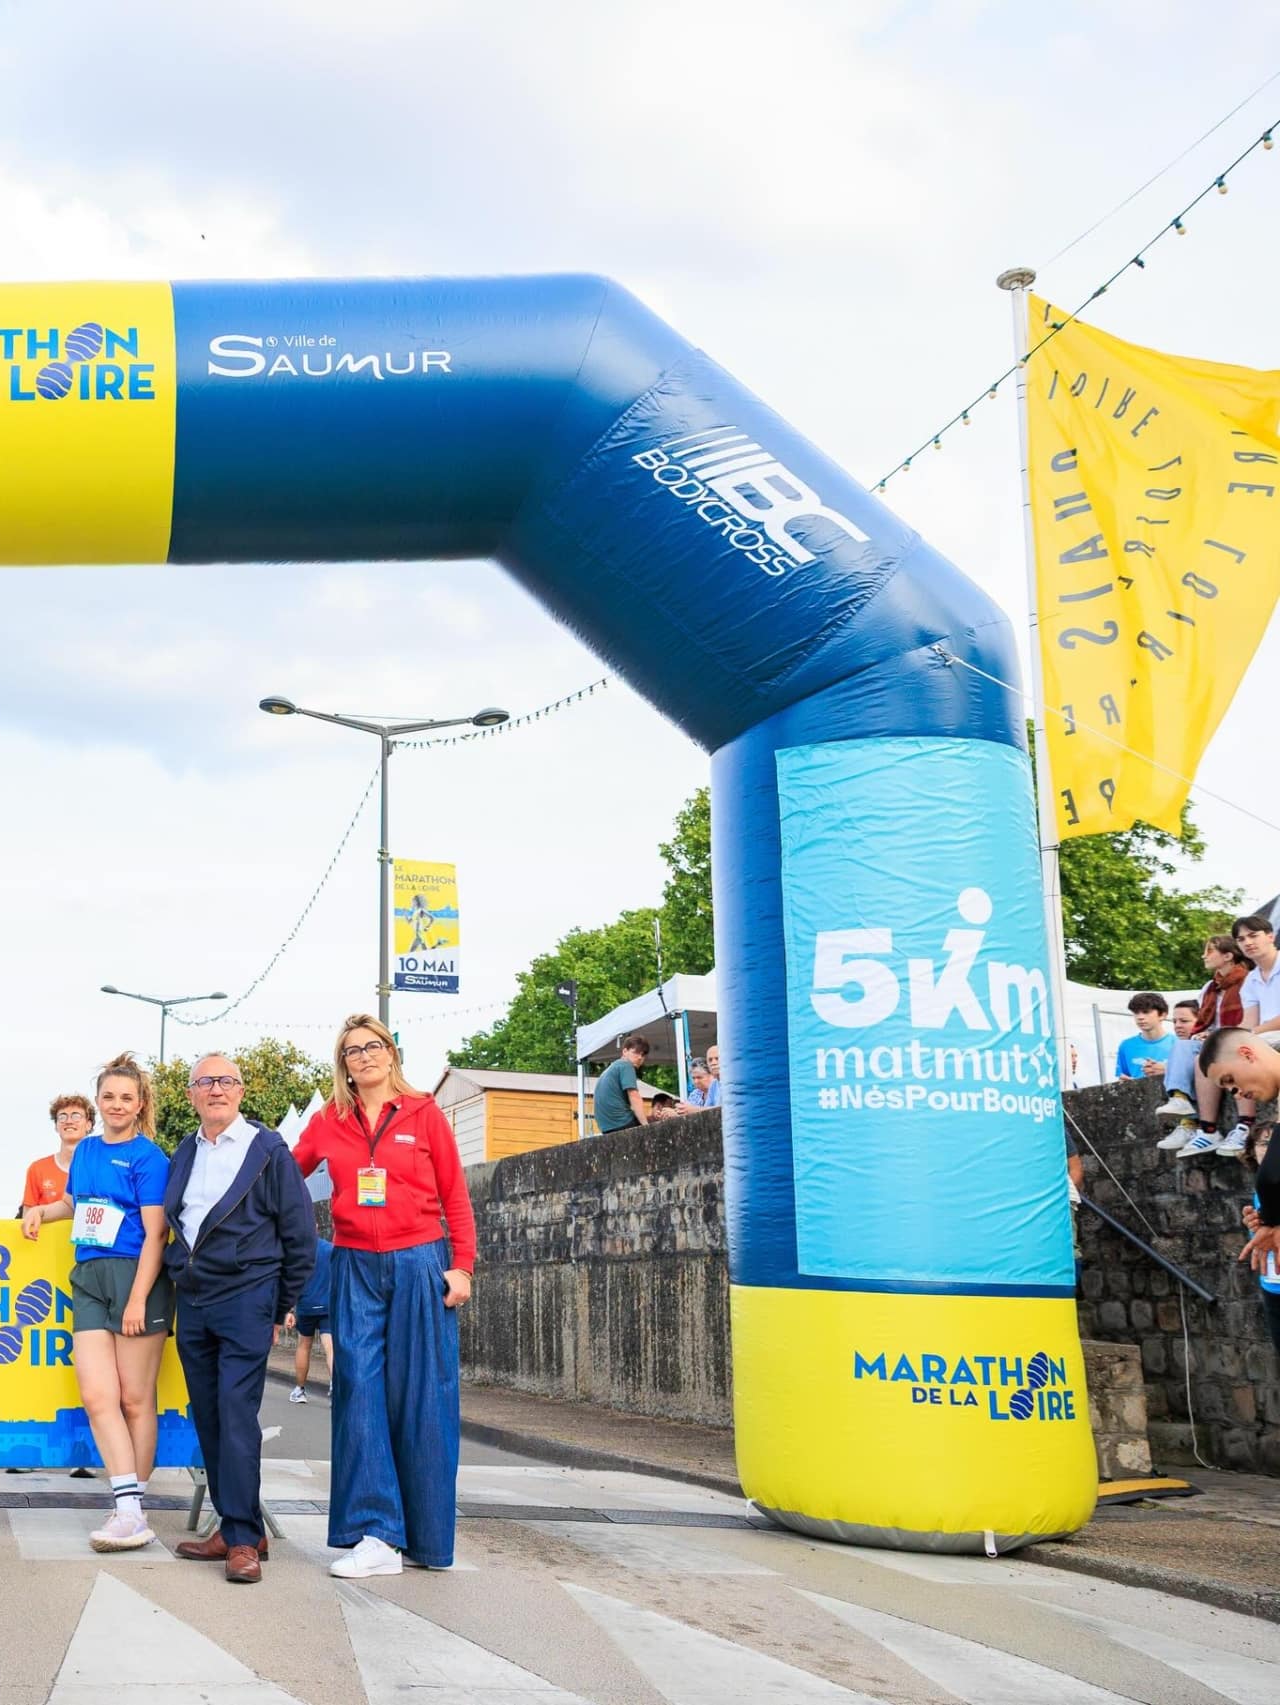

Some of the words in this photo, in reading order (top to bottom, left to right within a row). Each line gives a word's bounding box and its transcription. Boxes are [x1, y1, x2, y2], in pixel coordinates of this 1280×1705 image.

[208, 335, 453, 380] SAUMUR
[283, 335, 315, 347] Ville
[319, 335, 336, 347] de
[10, 361, 156, 401] LOIRE
[631, 448, 798, 576] BODYCROSS
[394, 874, 457, 885] MARATHON
[399, 957, 418, 972] 10
[423, 960, 454, 973] MAI
[816, 1040, 1029, 1084] matmut
[818, 1084, 1057, 1122] #NésPourBouger
[85, 1207, 105, 1225] 988
[853, 1351, 1067, 1389] MARATHON
[912, 1387, 943, 1405] DE
[949, 1389, 979, 1406] LA
[988, 1389, 1076, 1421] LOIRE
